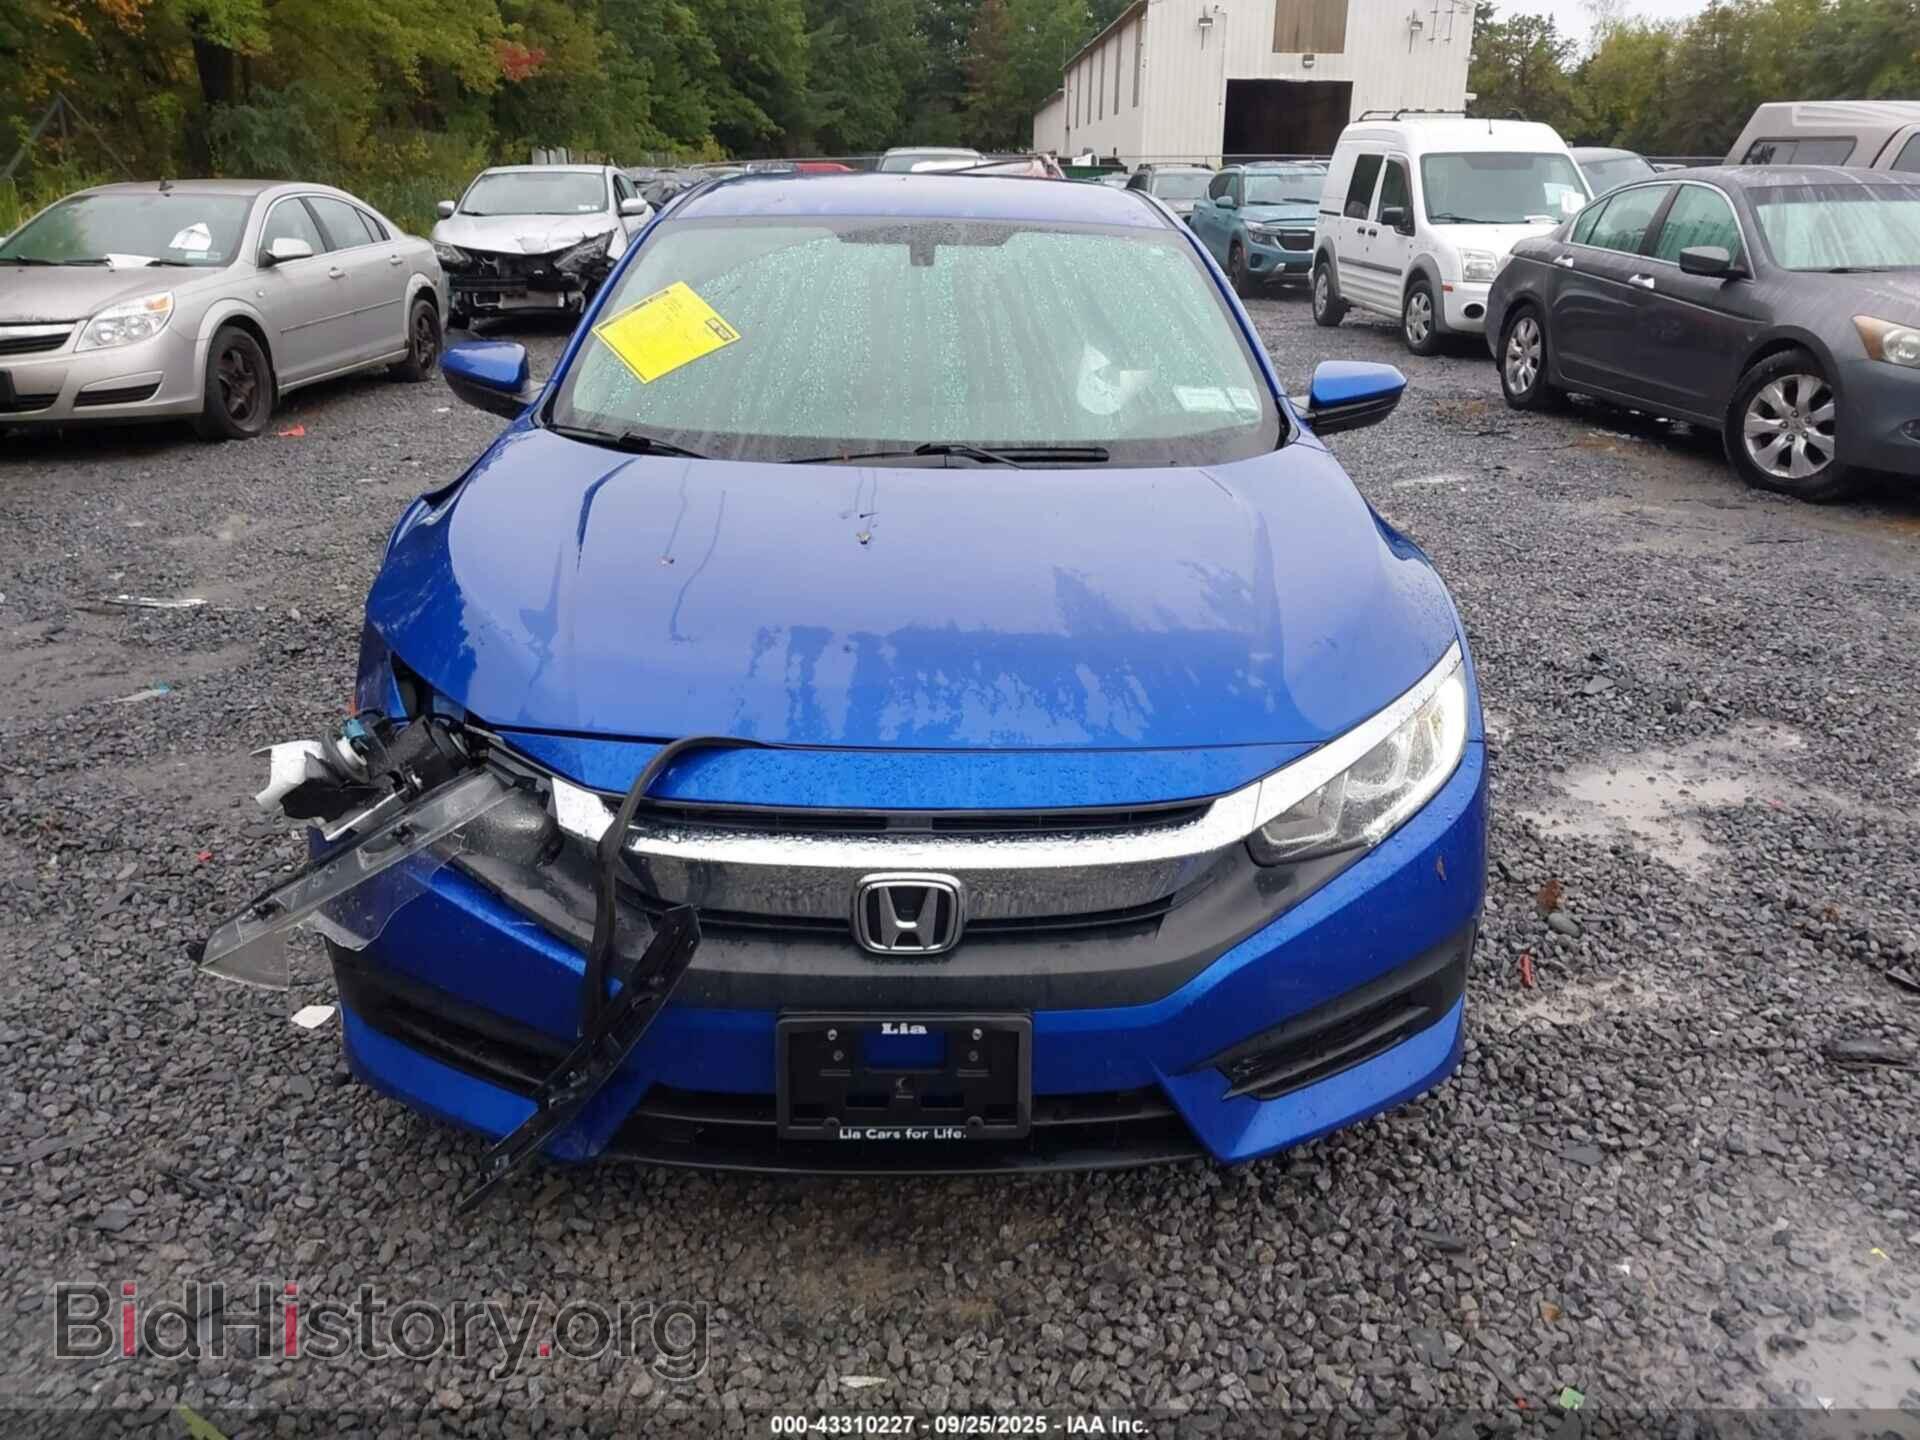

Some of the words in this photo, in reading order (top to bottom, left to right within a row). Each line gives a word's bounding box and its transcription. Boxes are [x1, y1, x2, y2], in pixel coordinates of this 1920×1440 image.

[881, 1022, 928, 1035] Lia
[839, 1128, 861, 1139] Lia
[865, 1128, 901, 1139] Cars
[905, 1128, 929, 1139] for
[934, 1128, 967, 1139] Life.
